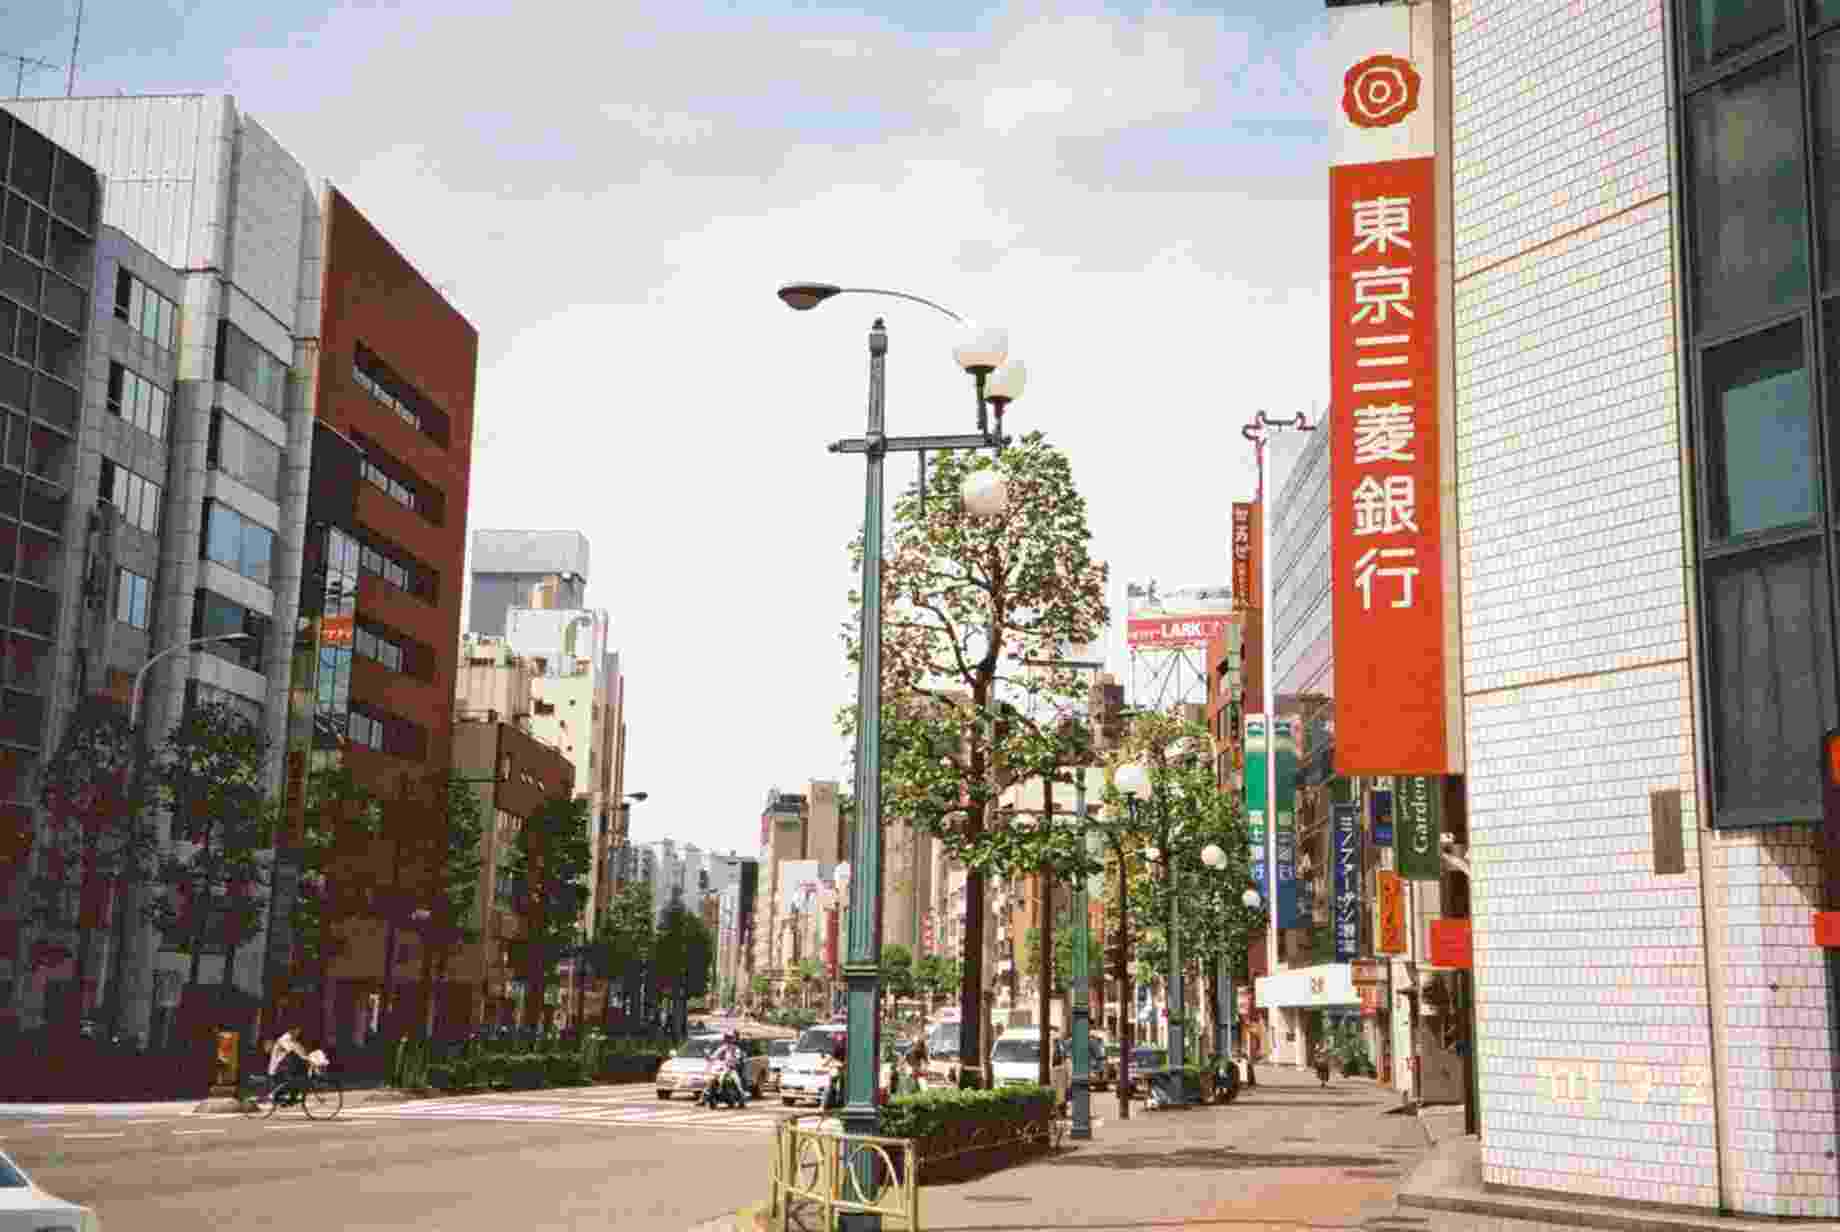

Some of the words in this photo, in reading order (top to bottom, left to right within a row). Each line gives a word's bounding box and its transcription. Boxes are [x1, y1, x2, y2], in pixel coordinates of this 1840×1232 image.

[1350, 195, 1421, 611] 東京三菱銀行
[1161, 623, 1202, 640] LARK
[1410, 776, 1429, 853] Garden
